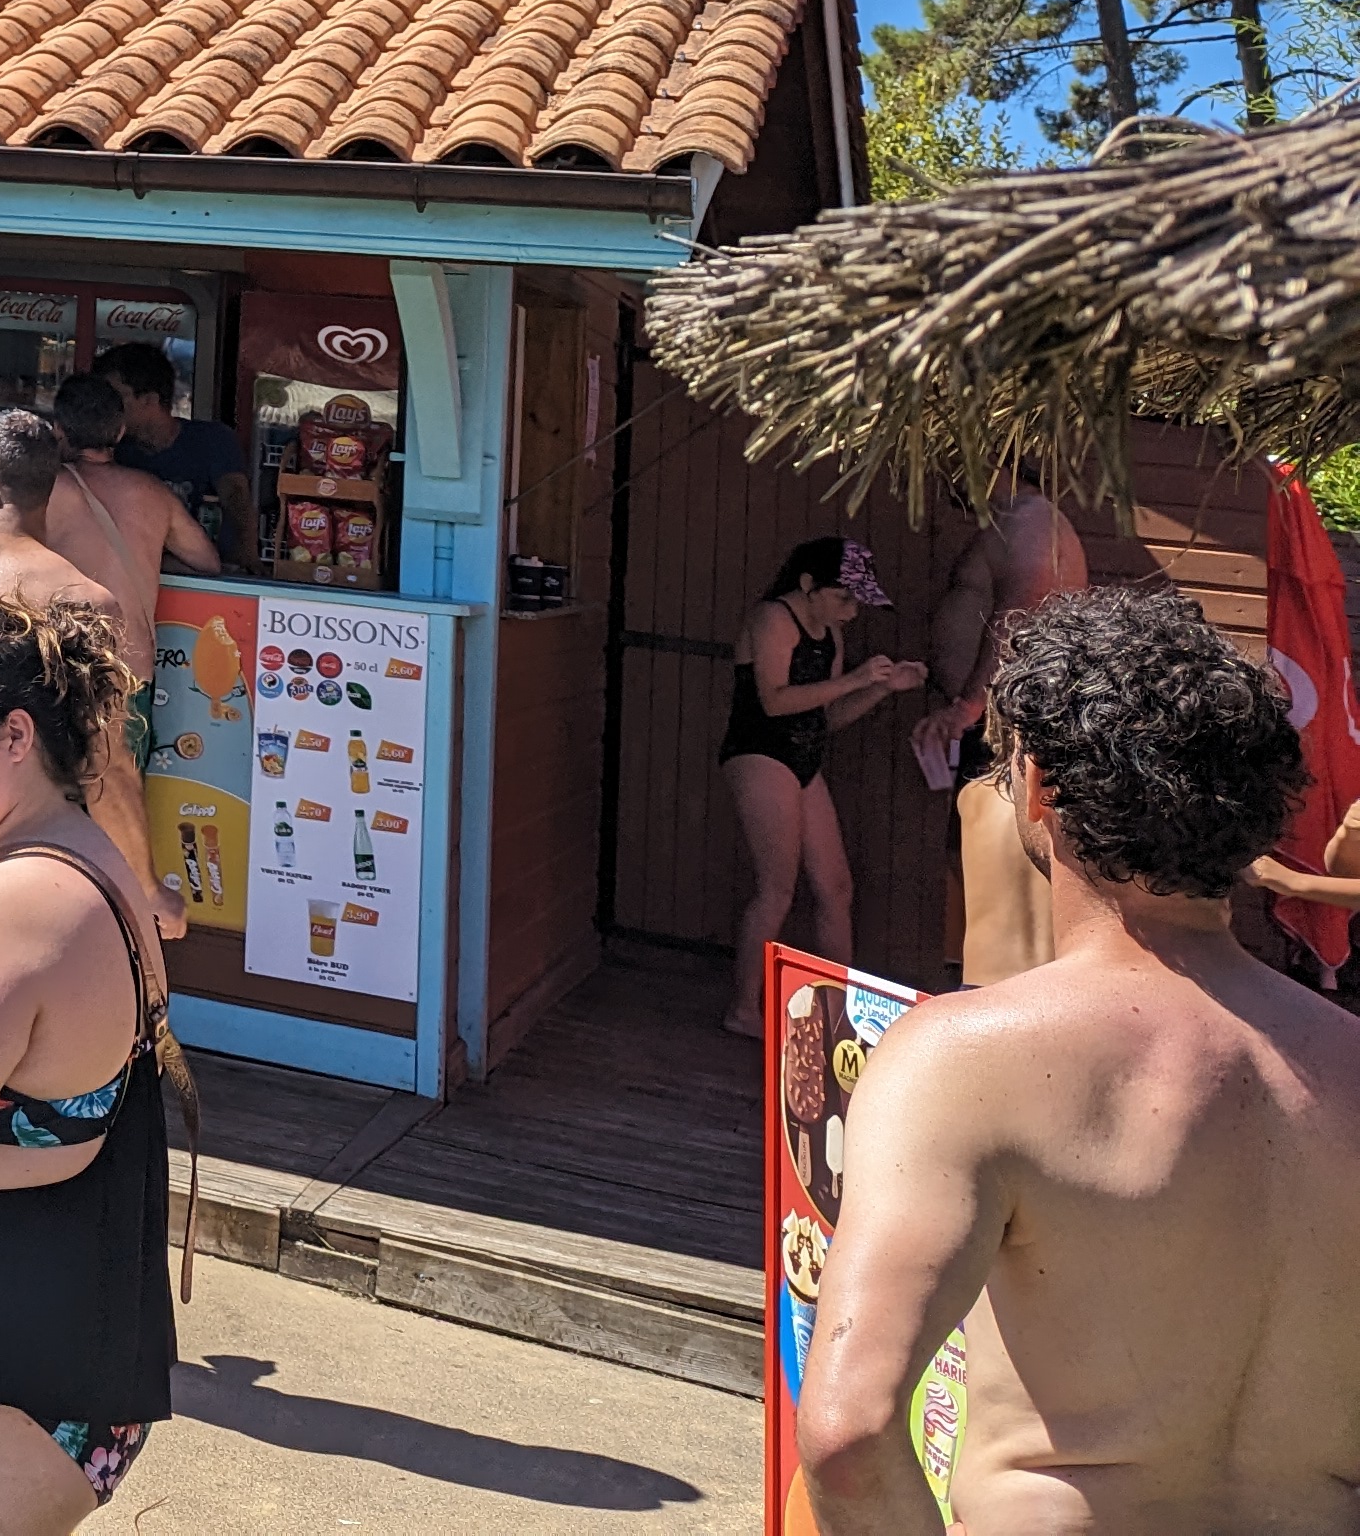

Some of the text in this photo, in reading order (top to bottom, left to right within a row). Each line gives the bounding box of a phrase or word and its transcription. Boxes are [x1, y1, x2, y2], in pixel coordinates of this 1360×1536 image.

[107, 304, 184, 332] Coca-Cola
[268, 609, 420, 650] BOISSONS
[155, 649, 186, 668] ERO
[353, 661, 379, 673] 50 cl
[179, 802, 216, 817] Calippo
[330, 961, 349, 971] BUD
[934, 1356, 967, 1385] HARIB
